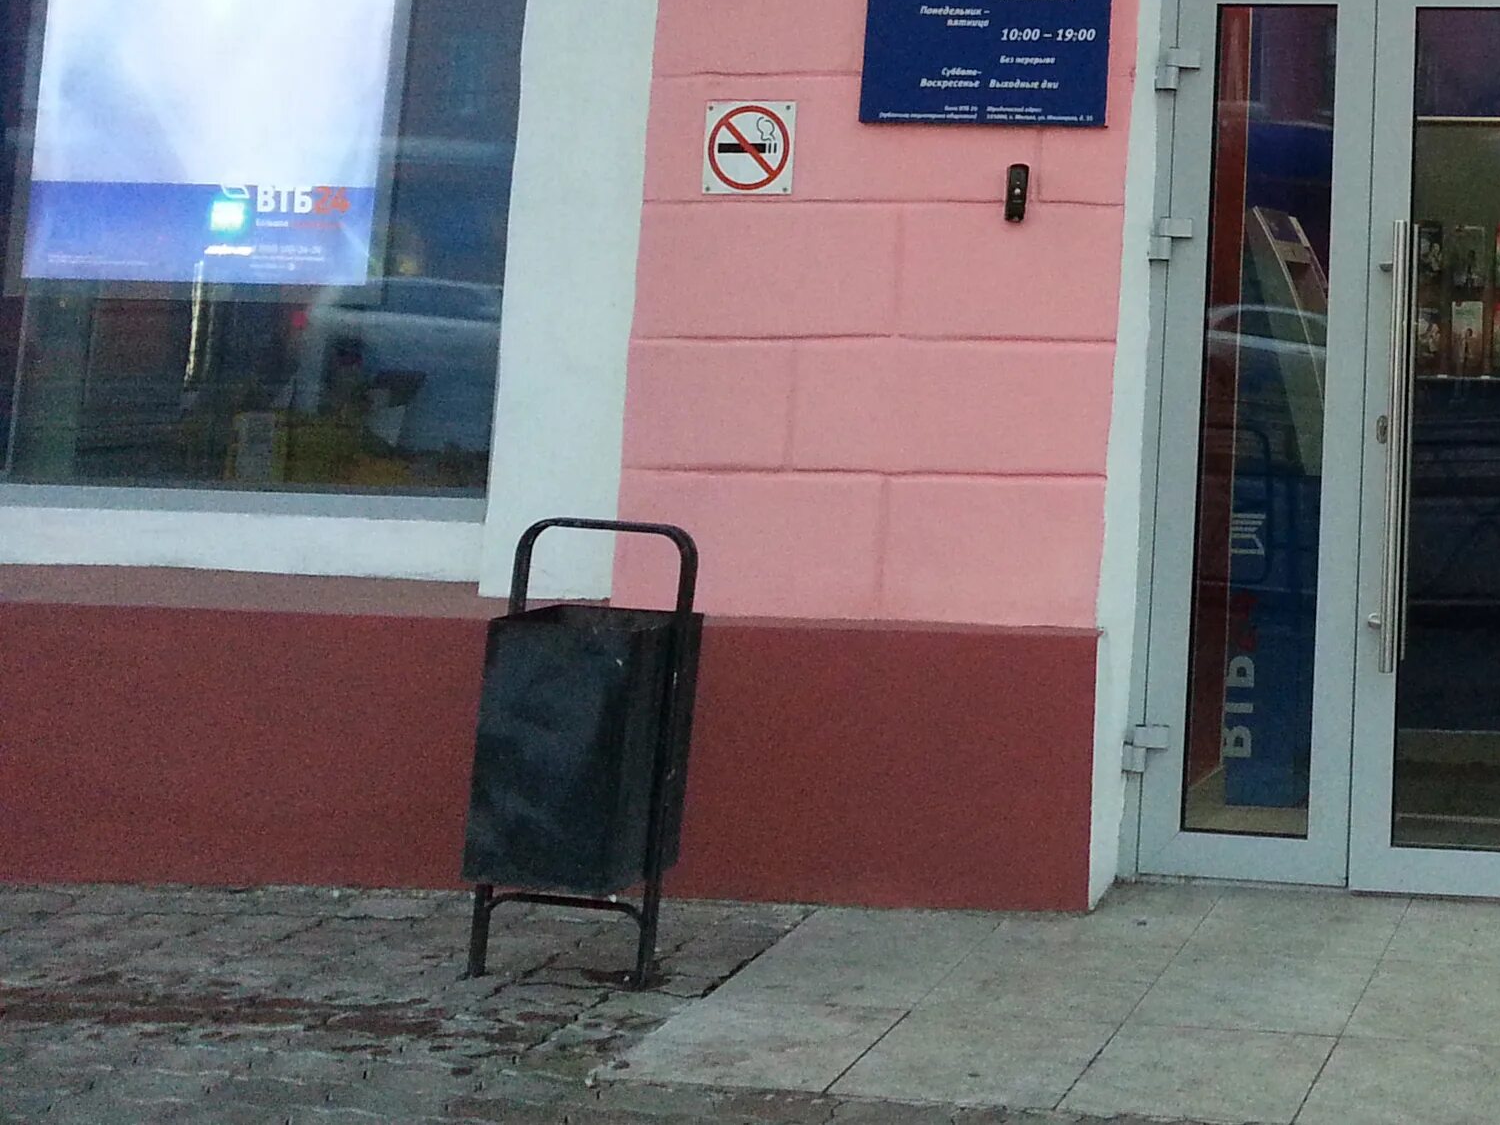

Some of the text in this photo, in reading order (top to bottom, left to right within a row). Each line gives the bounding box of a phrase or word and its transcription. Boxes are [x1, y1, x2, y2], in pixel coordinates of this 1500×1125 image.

[1000, 28, 1041, 42] 10:00
[1056, 28, 1096, 42] 19:00
[256, 184, 351, 215] ВТБ24
